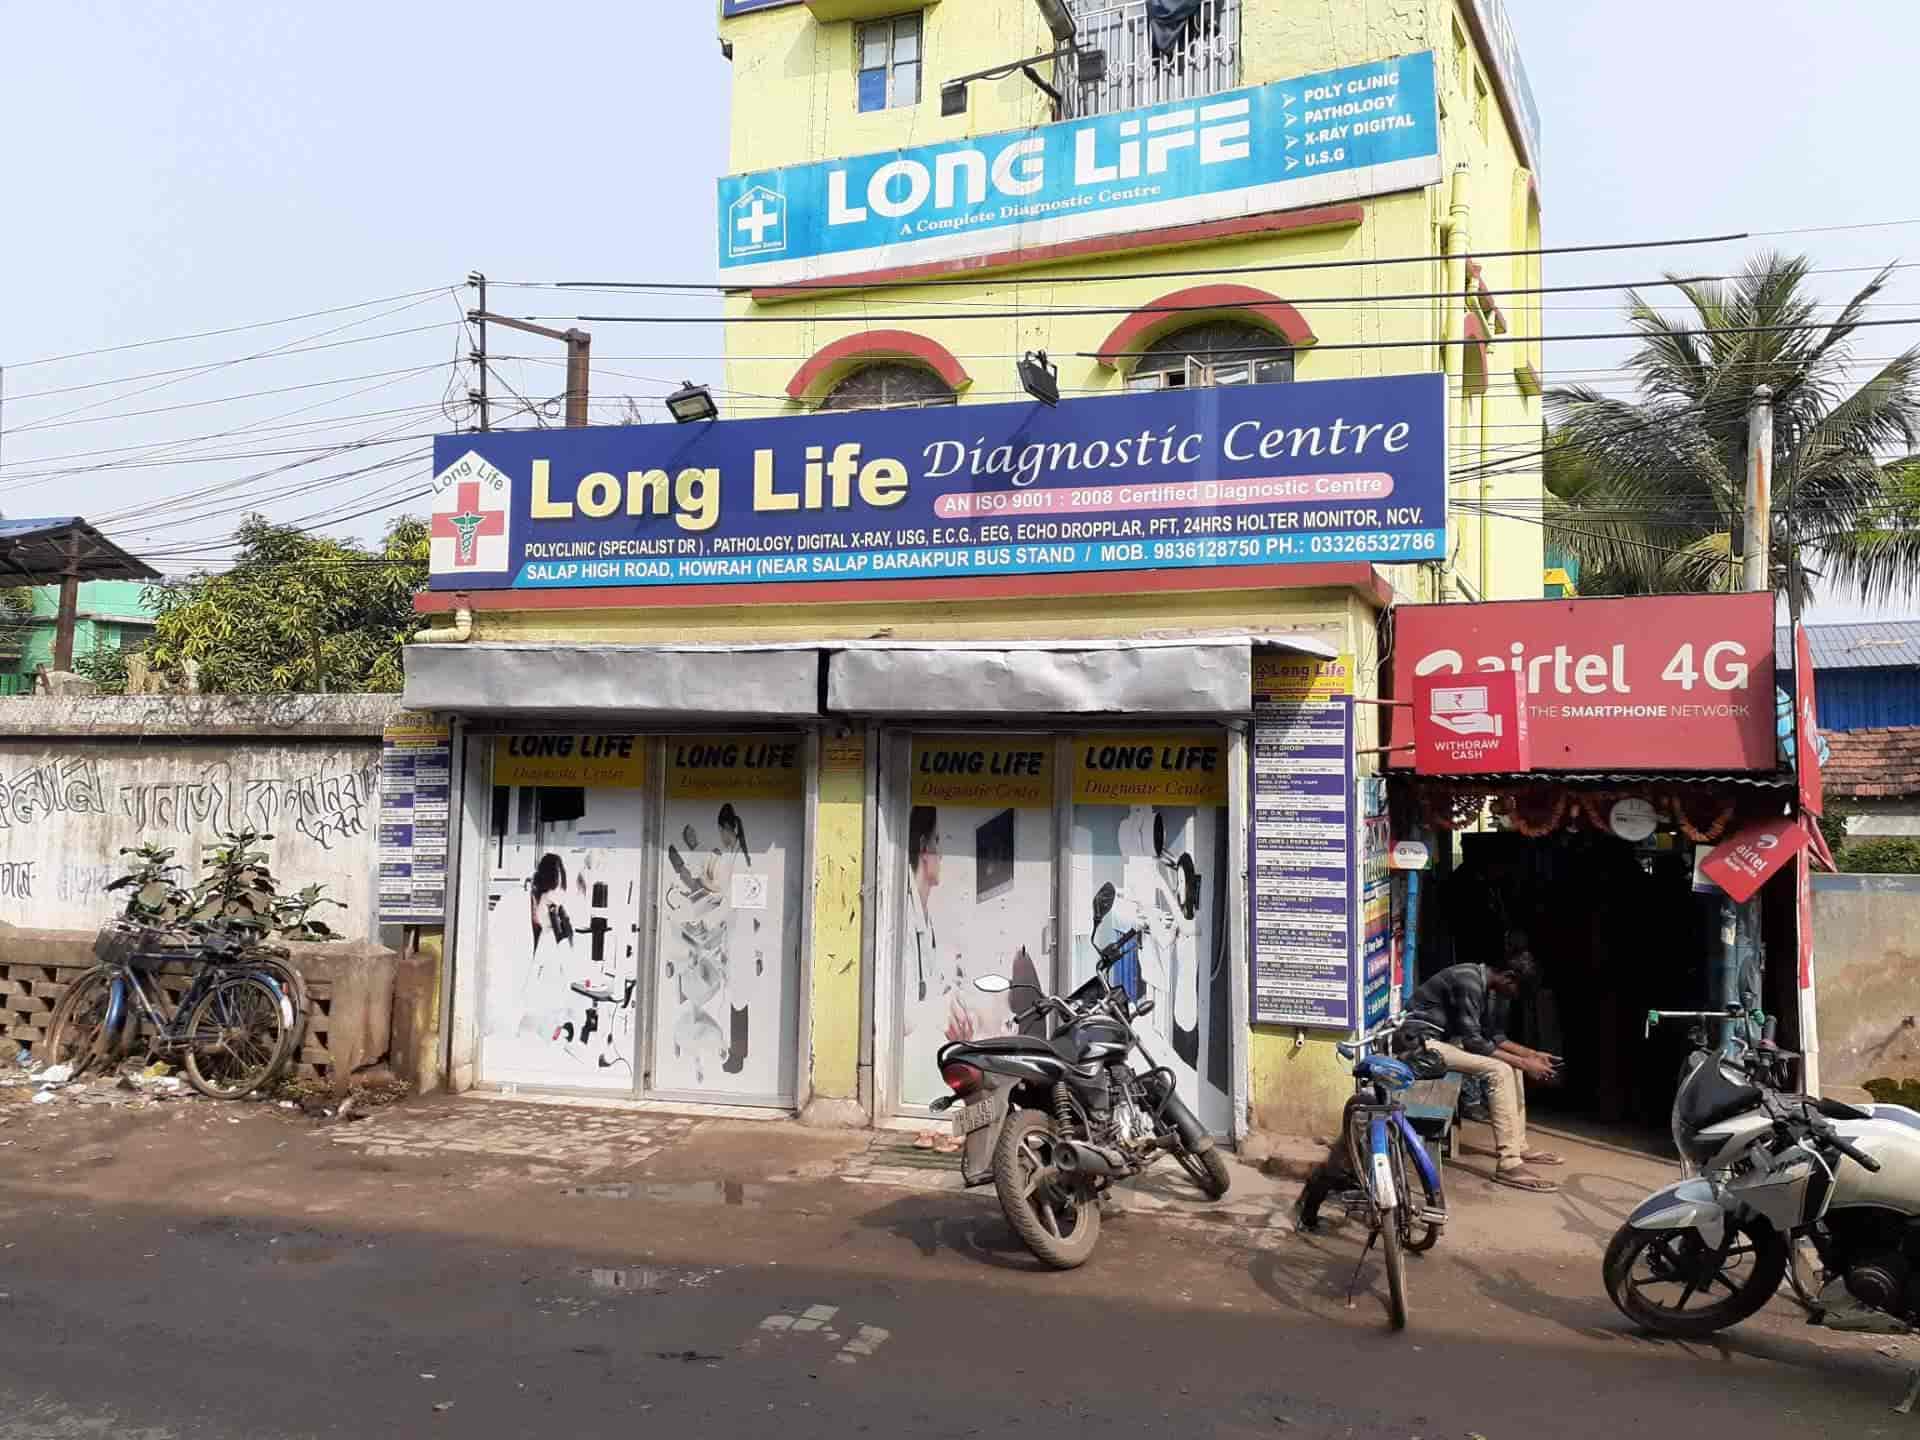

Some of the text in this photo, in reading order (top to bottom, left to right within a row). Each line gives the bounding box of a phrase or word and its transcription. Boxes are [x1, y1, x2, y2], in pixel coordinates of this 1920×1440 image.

[1304, 72, 1400, 103] POLY CLINIC
[1304, 94, 1396, 124] PATHOLOGY
[1305, 114, 1416, 146] X-RAY DIGITAL
[900, 184, 1161, 236] A Complete Diagnostic Centre
[432, 461, 504, 495] Long Life
[530, 417, 1410, 531] Long Life Diagnostic Centre
[944, 495, 970, 512] AN
[975, 493, 1007, 511] ISO
[1012, 491, 1053, 508] 9001
[1071, 489, 1113, 505] 2008
[1118, 484, 1198, 504] Certified
[1205, 480, 1308, 502] Diagnostic
[1315, 477, 1382, 495] Centre
[525, 541, 595, 558] POLYCLINIC
[599, 539, 674, 557] (SPECIALIST
[798, 533, 848, 550] DIGITAL
[1017, 523, 1056, 541] ECHO
[1184, 515, 1232, 534] 24HRS
[1236, 512, 1299, 531] HOLTER
[527, 564, 577, 580] SALAP
[581, 562, 620, 578] HIGH
[679, 559, 752, 576] HOWRAH
[756, 557, 808, 577] (NEAR
[812, 555, 868, 573] SALAP
[873, 550, 969, 570] BARAKPUR
[975, 548, 1010, 566] BUS
[1015, 546, 1075, 564] STAND
[1101, 544, 1149, 562] MOB.
[1154, 540, 1260, 560] 9836128750
[1311, 533, 1435, 554] 03326532786
[1315, 662, 1345, 675] Life
[1662, 640, 1749, 692] 4G
[1528, 704, 1749, 718] THE SMARTPHONE NETWORK
[508, 735, 636, 759] LONG LIFE
[675, 744, 794, 769] LONG LIFE
[1085, 745, 1218, 773] LONG LIFE
[1434, 739, 1500, 751] WITHDRAW
[1451, 749, 1483, 760] CASH
[919, 751, 1043, 776] LONG LIFE
[1735, 844, 1769, 872] airtel
